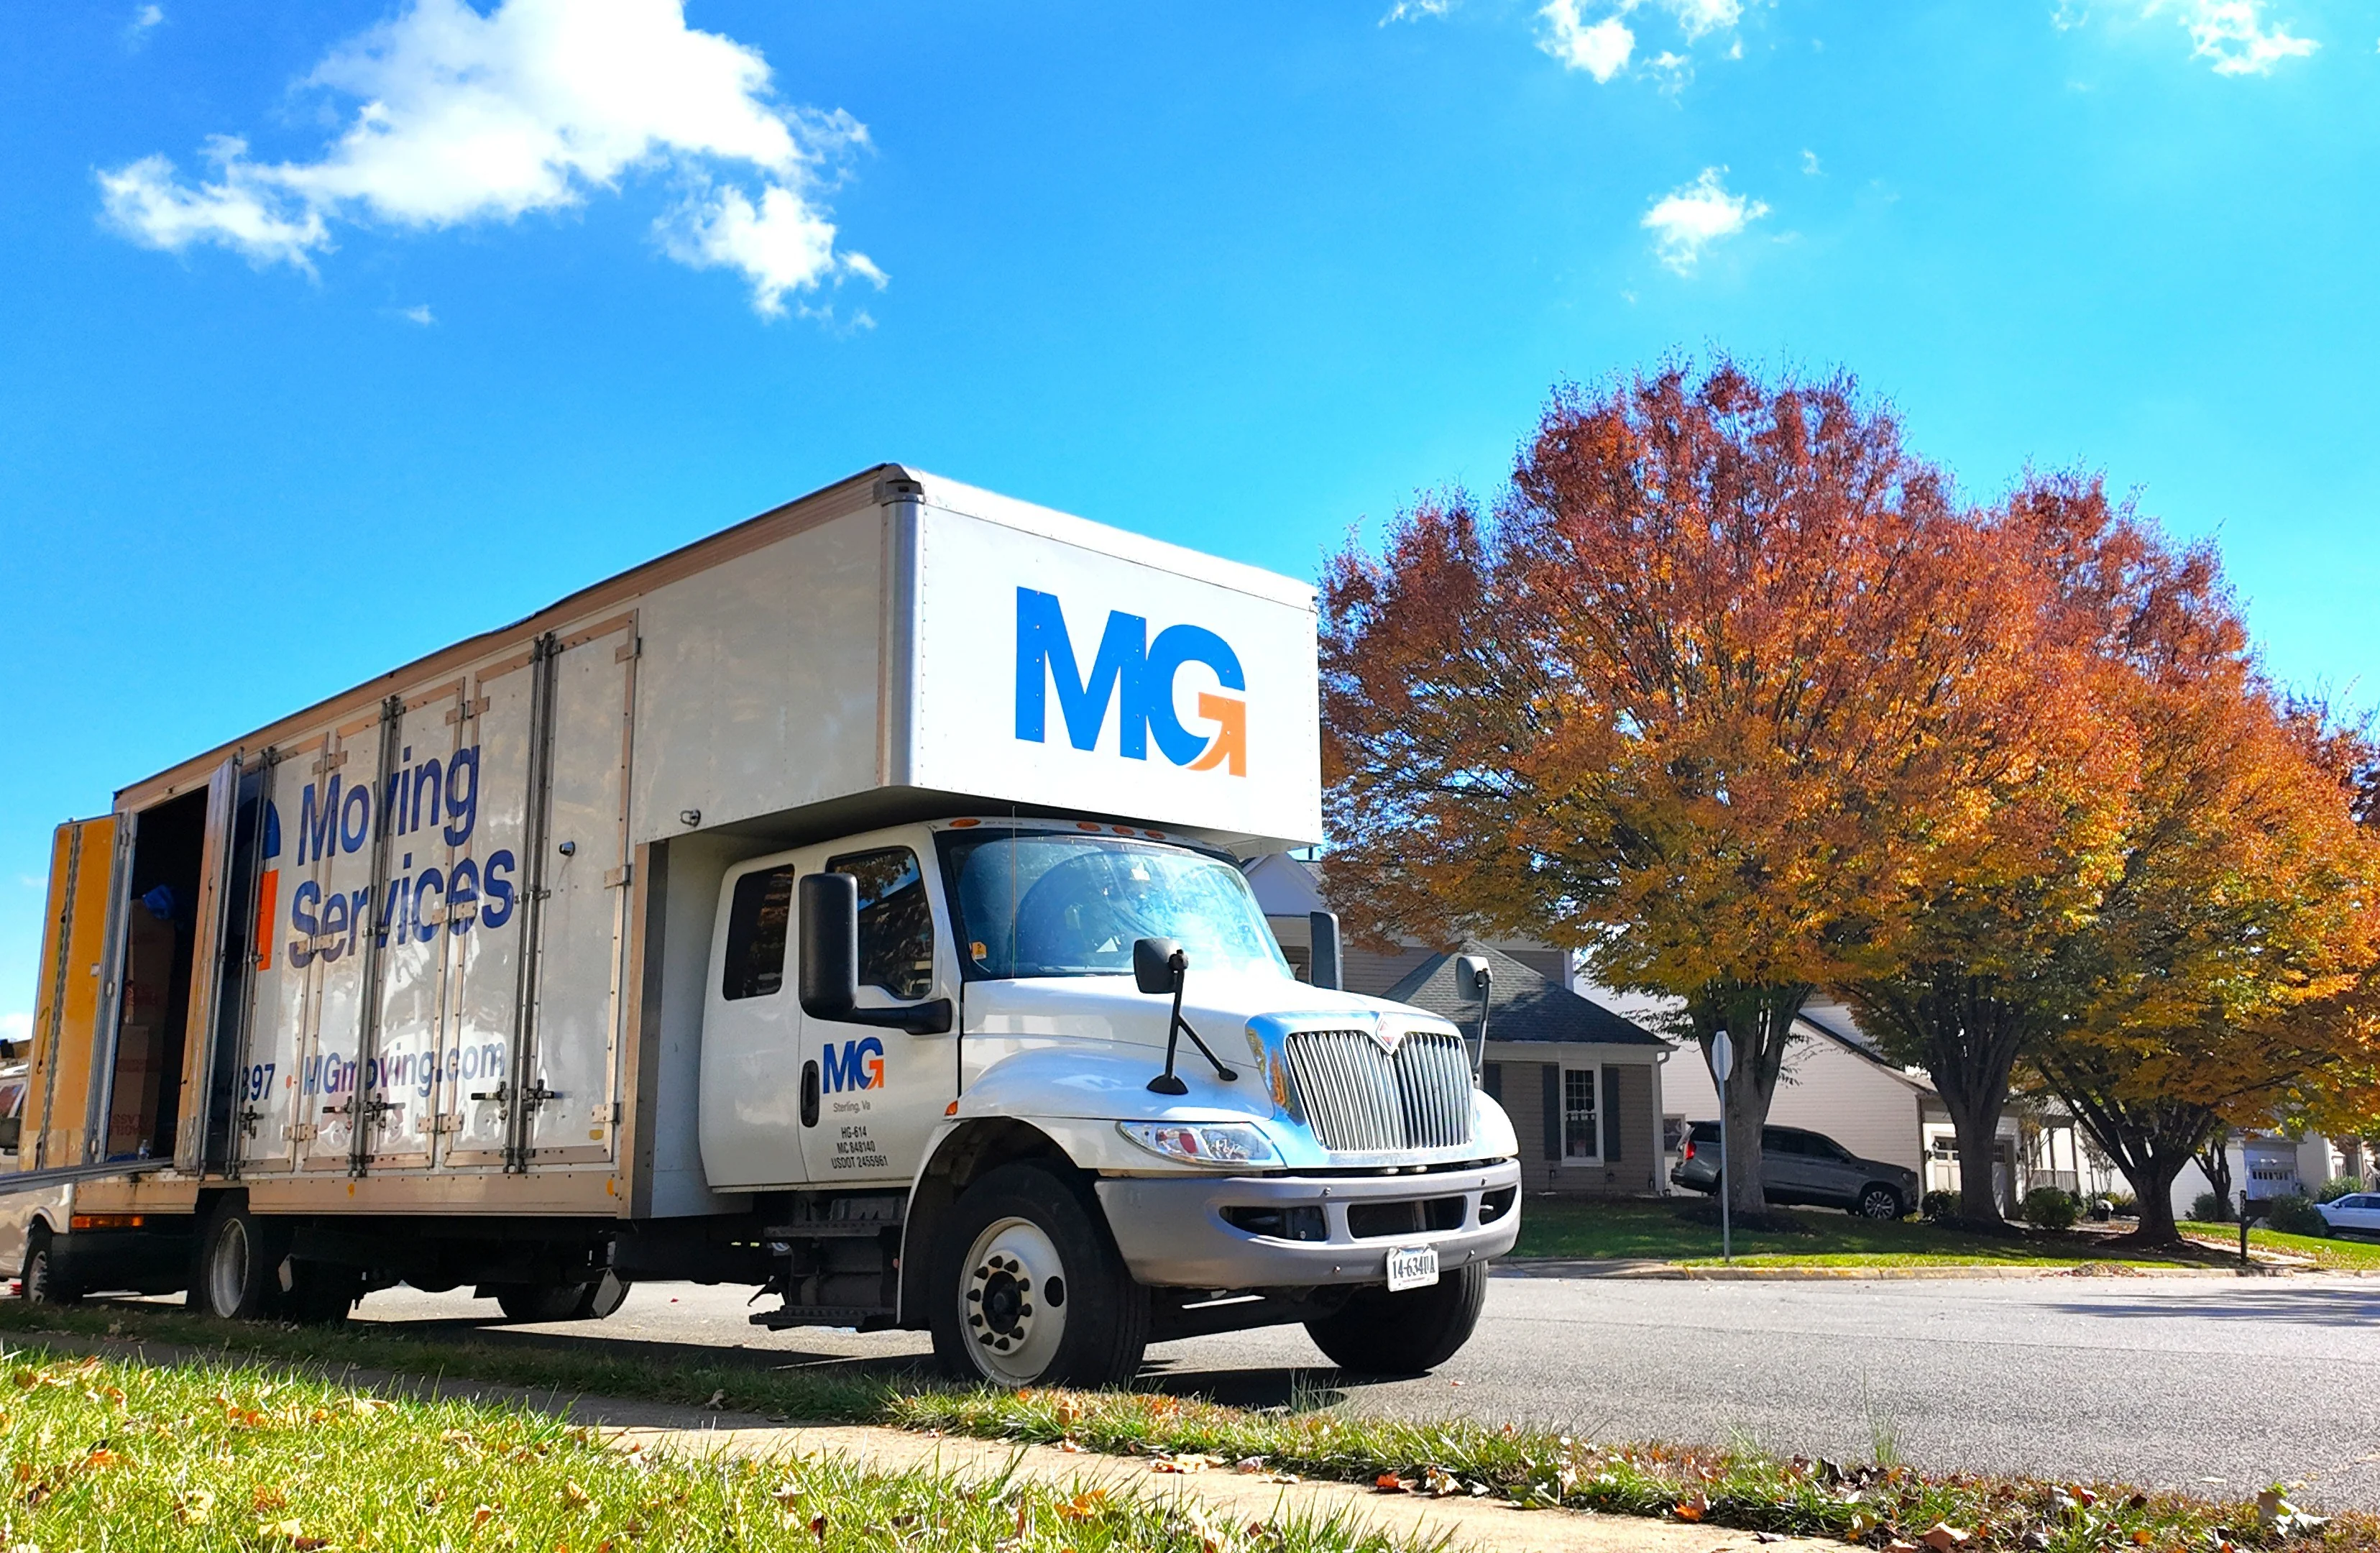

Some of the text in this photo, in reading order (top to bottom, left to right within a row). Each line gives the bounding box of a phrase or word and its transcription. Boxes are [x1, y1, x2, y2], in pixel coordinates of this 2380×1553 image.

[1015, 585, 1246, 778] MG
[297, 745, 480, 866] Moving
[289, 849, 515, 968] Services
[303, 1042, 505, 1098] MGmoving.com
[822, 1037, 885, 1094] MG
[837, 1142, 849, 1154] MC
[840, 1125, 867, 1139] HG-614
[831, 1156, 855, 1169] USDOT
